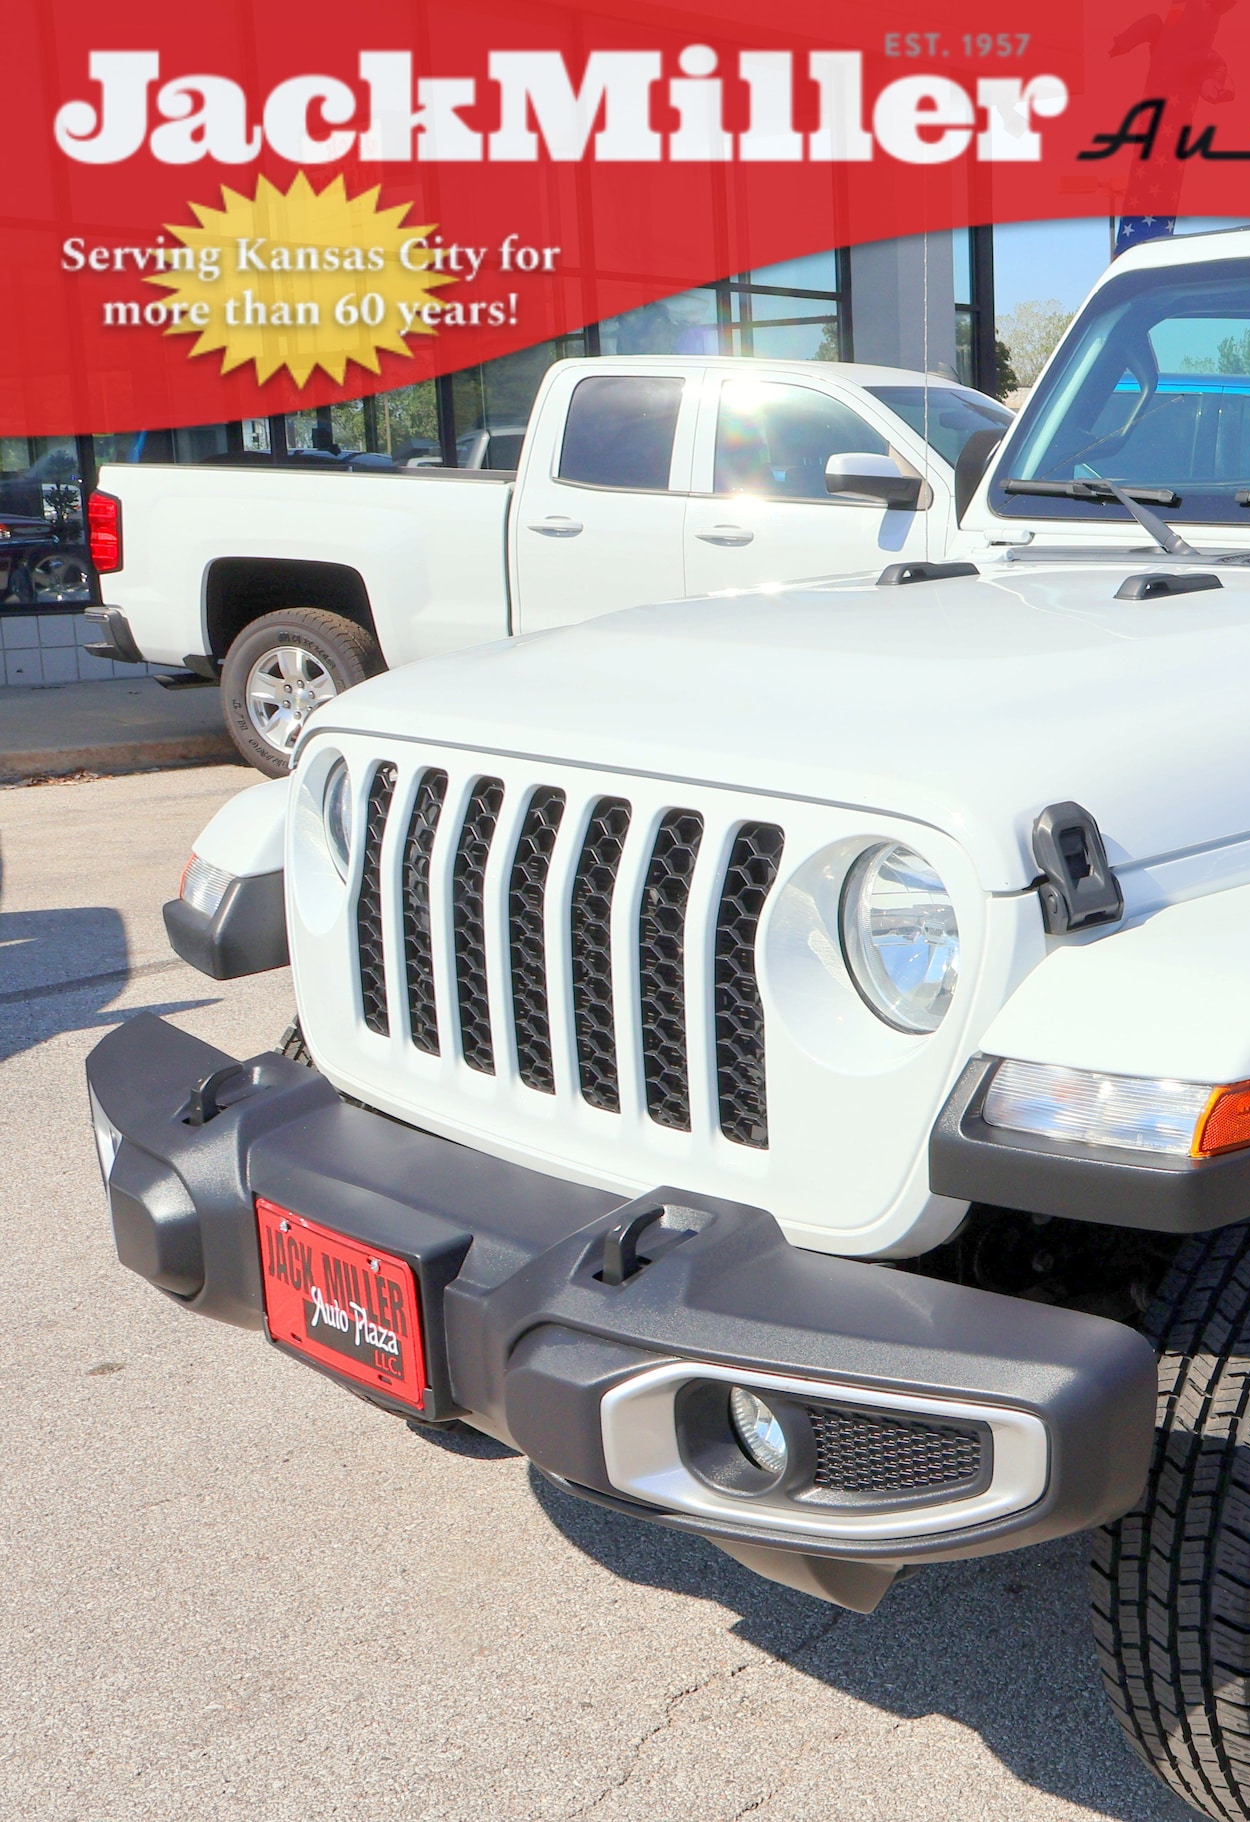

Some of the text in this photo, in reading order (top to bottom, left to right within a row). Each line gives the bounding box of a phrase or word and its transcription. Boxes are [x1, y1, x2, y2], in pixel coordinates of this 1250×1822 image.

[265, 1225, 409, 1338] JACK MILLER
[310, 1286, 400, 1356] Auto Plaza
